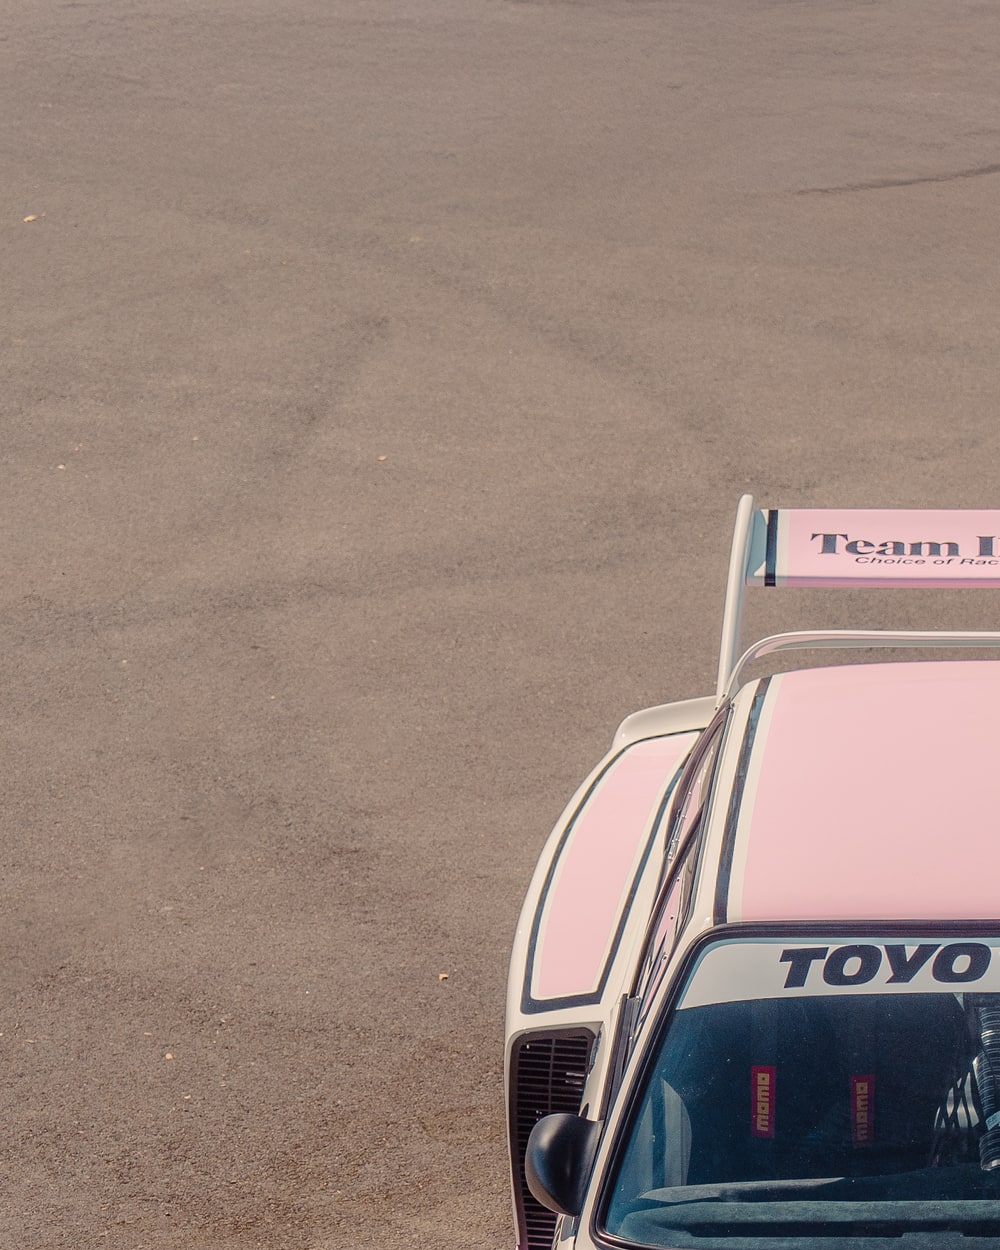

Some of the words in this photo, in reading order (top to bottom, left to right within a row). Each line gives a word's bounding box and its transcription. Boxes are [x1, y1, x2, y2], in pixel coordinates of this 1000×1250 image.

[810, 533, 960, 556] Team
[855, 556, 926, 565] Choice
[933, 557, 954, 565] of
[779, 942, 992, 989] TOYO
